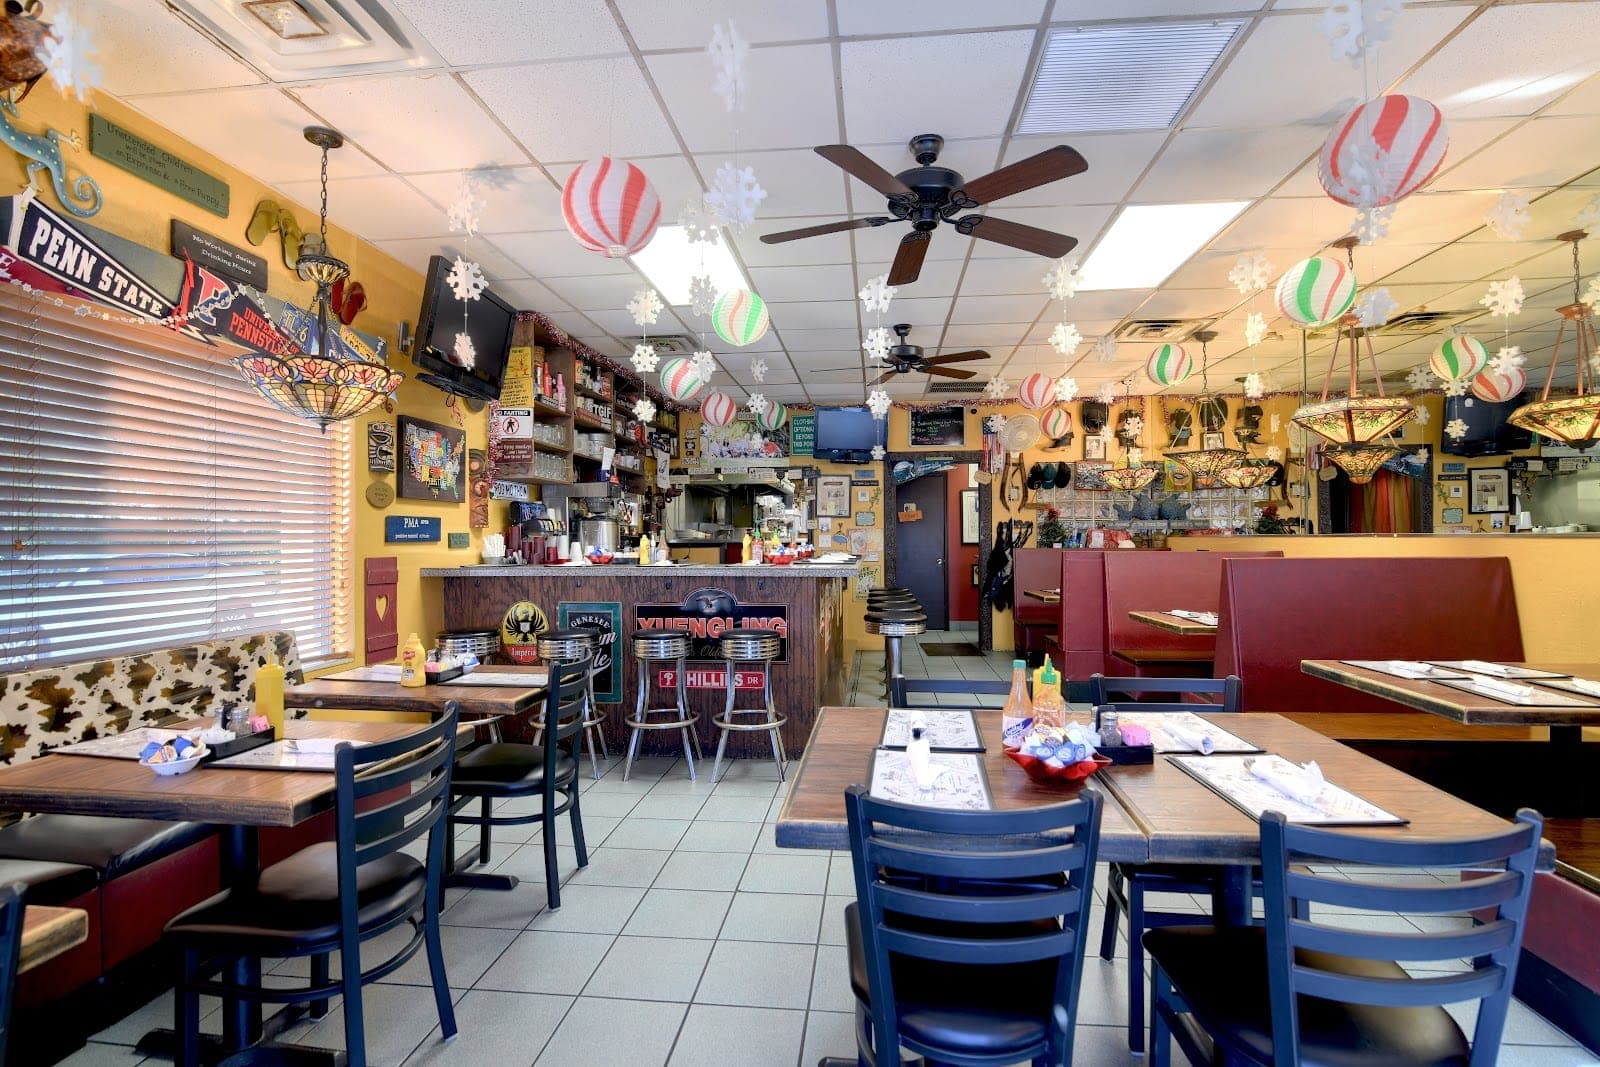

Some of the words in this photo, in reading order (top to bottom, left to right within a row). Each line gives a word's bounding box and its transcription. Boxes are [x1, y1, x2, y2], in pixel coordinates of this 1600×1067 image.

[107, 121, 156, 154] Unattended
[161, 151, 194, 175] Children
[192, 234, 204, 245] No
[204, 238, 233, 258] Working
[235, 254, 257, 268] during
[29, 217, 97, 284] PENN
[98, 266, 163, 317] STATE
[201, 249, 232, 267] Drinking
[232, 261, 253, 275] Hours
[593, 404, 612, 419] TGIF
[403, 517, 419, 528] PMA
[571, 616, 611, 630] GENESEE
[512, 648, 537, 660] Imperia
[686, 672, 743, 687] HILLIS
[747, 676, 758, 684] DR
